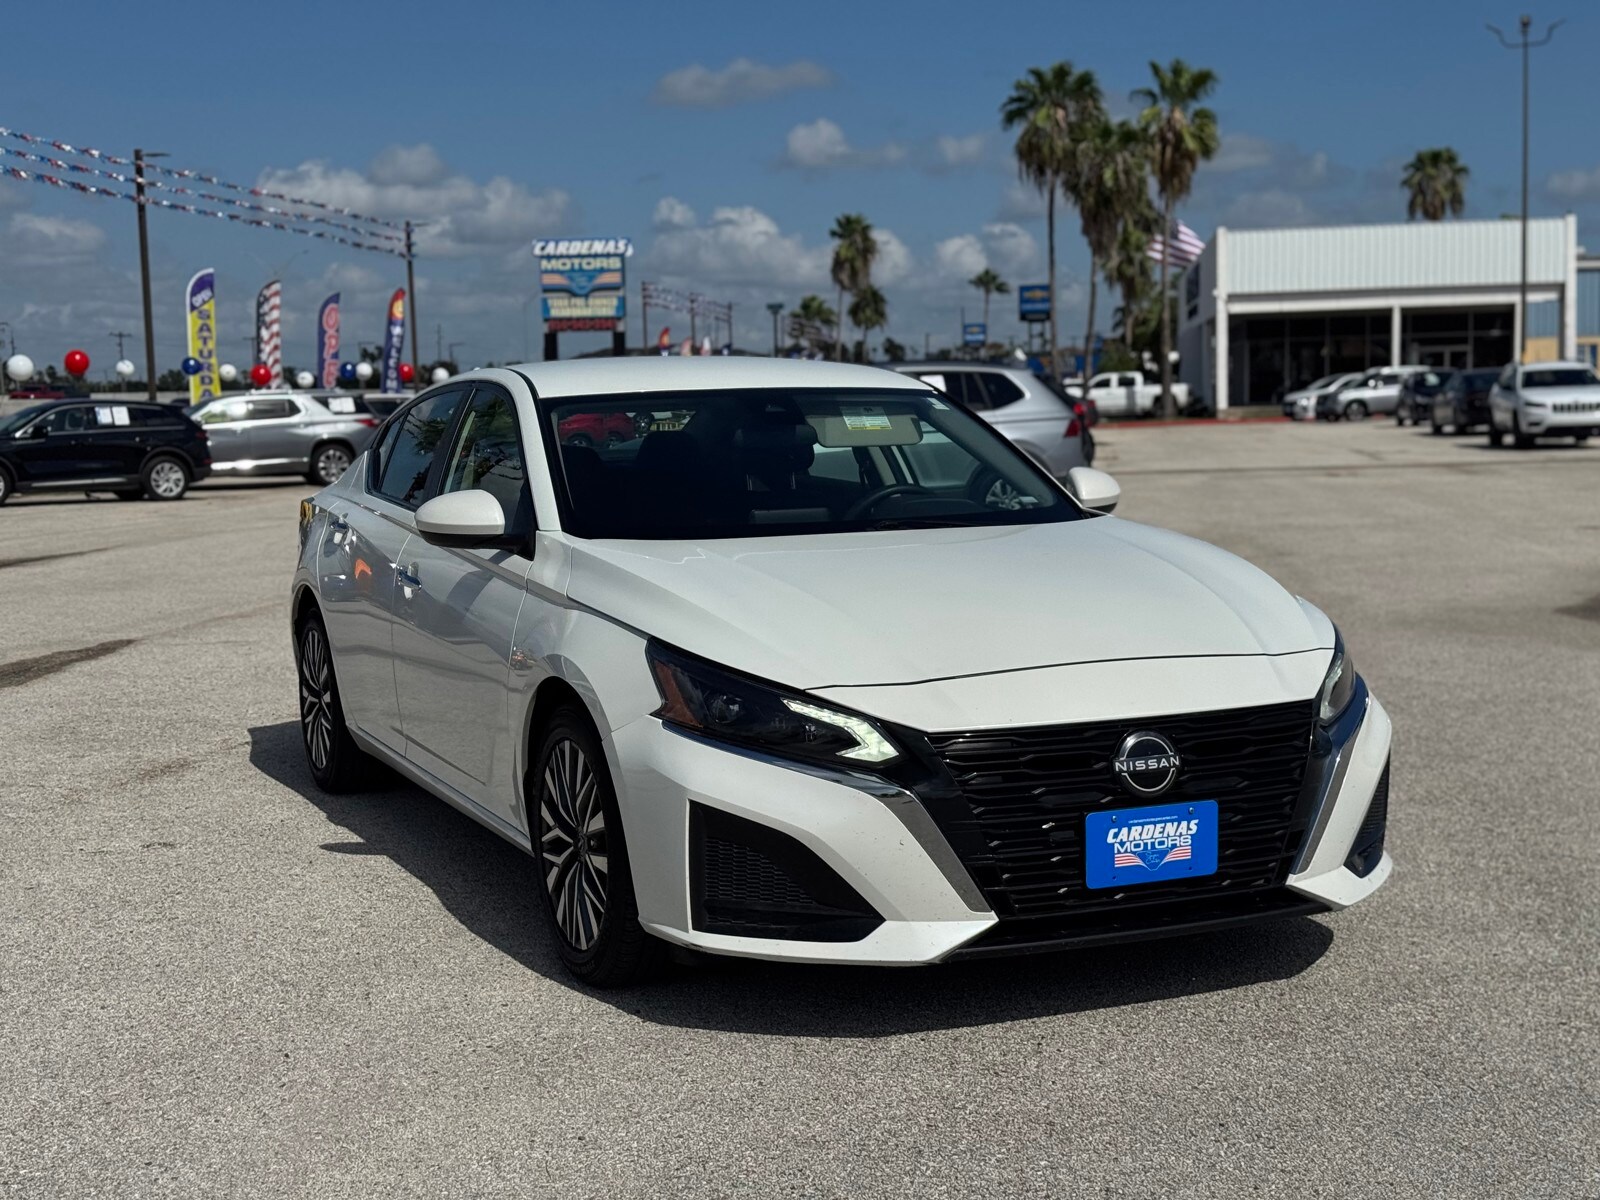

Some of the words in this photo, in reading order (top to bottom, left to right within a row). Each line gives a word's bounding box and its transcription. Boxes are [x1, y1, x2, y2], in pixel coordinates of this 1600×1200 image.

[533, 239, 628, 256] CARDENAS
[541, 257, 622, 270] MOTORS
[1115, 755, 1180, 772] NISSAN
[1107, 819, 1199, 844] CARDENAS
[1113, 835, 1192, 854] MOTORS
